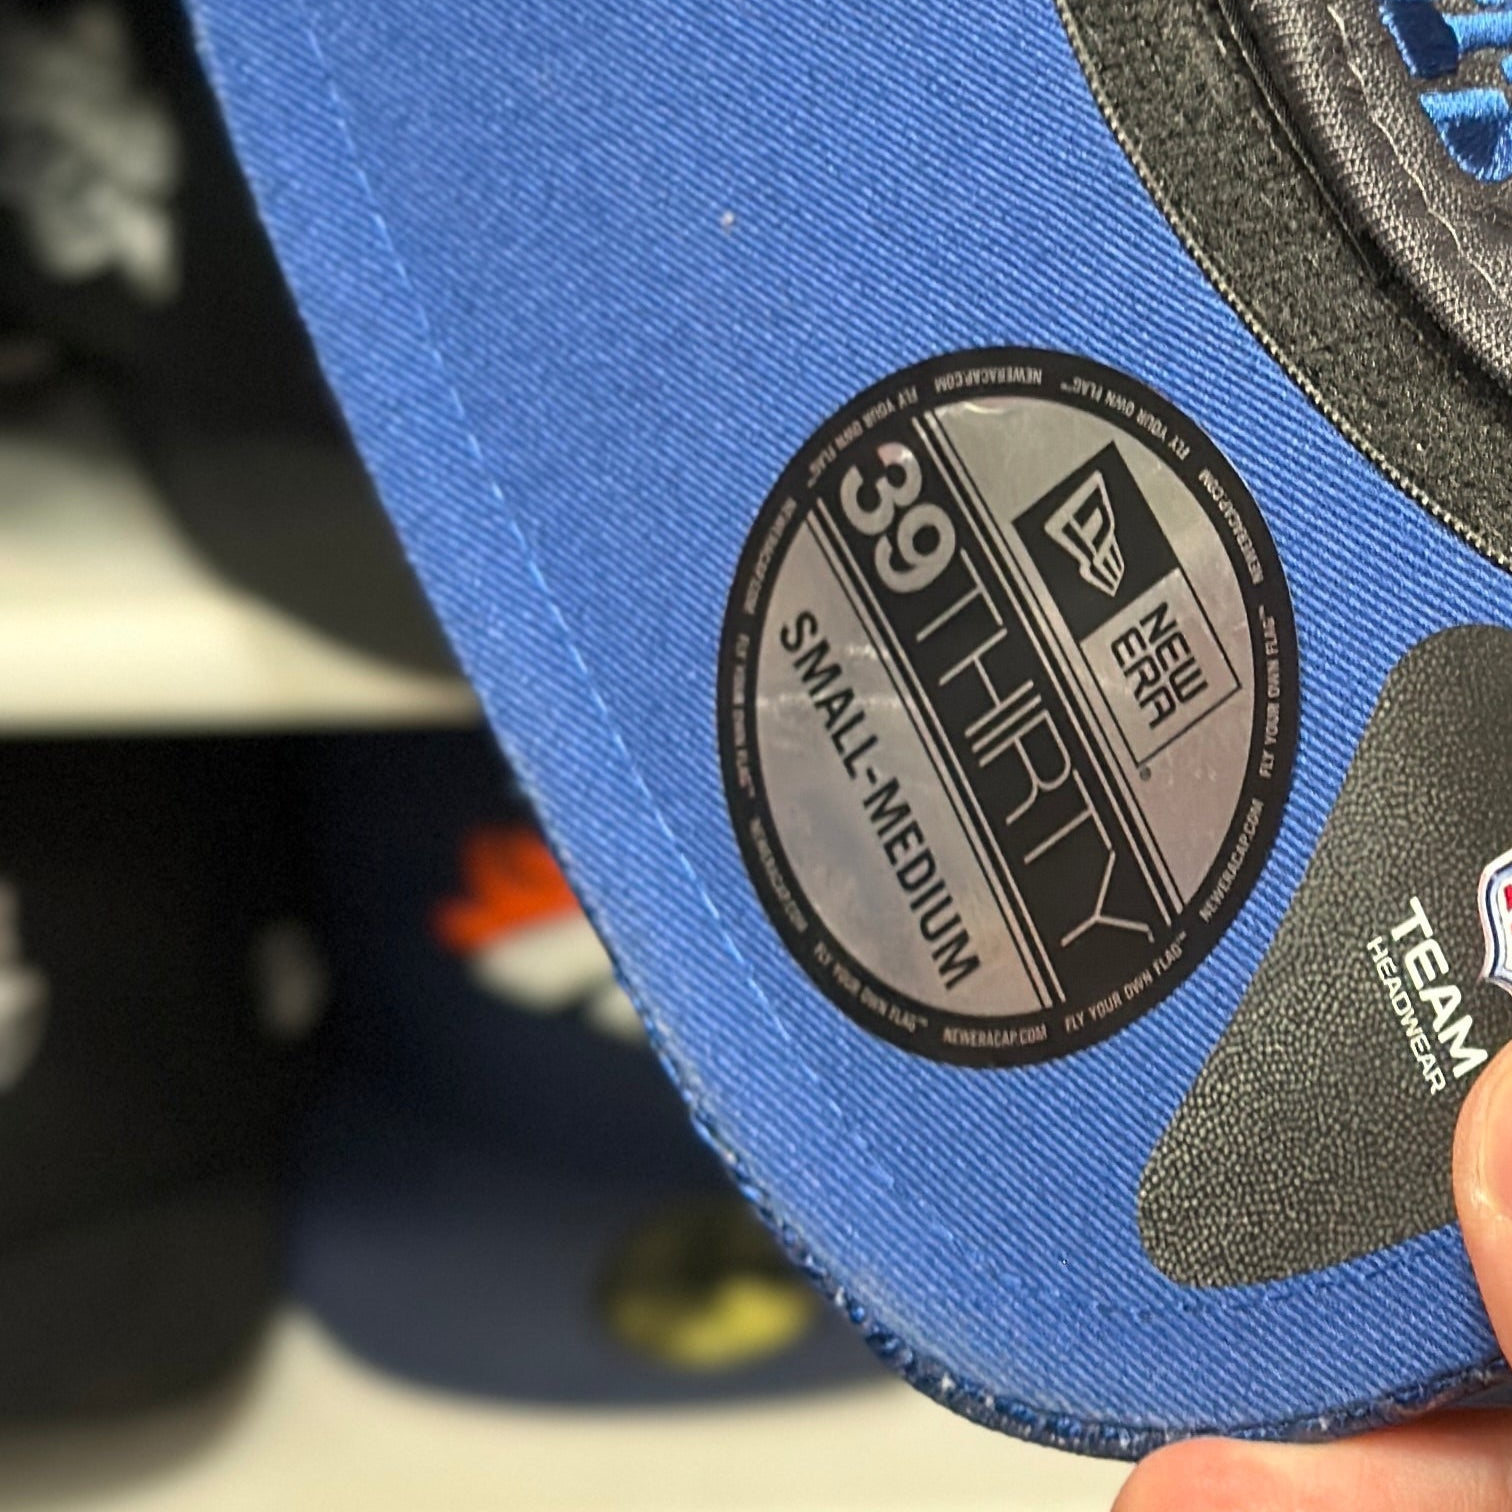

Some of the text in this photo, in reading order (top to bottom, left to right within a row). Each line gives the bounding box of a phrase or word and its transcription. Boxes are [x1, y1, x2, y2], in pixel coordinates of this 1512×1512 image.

[932, 366, 1043, 396] NEWERACAP.COM
[1104, 389, 1136, 417] OWN
[1134, 406, 1170, 442] YOUR
[1167, 434, 1190, 460] FLY
[1197, 464, 1265, 585] NEWERACAP.COM
[1111, 627, 1176, 730] ERA
[1139, 601, 1209, 703] NEW
[1266, 658, 1280, 698] OWN
[840, 442, 1156, 948] 39THIRTY
[1264, 702, 1279, 746] YOUR
[780, 610, 981, 991] SMALL-MEDIUM
[1258, 750, 1275, 779] FLY
[1197, 797, 1264, 924] NEWERACAP.COM
[1063, 1011, 1086, 1032] FLY
[1087, 991, 1123, 1022] YOUR
[1122, 968, 1154, 1000] OWN
[1366, 936, 1447, 1095] HEADWEAR
[1391, 896, 1488, 1079] TEAM
